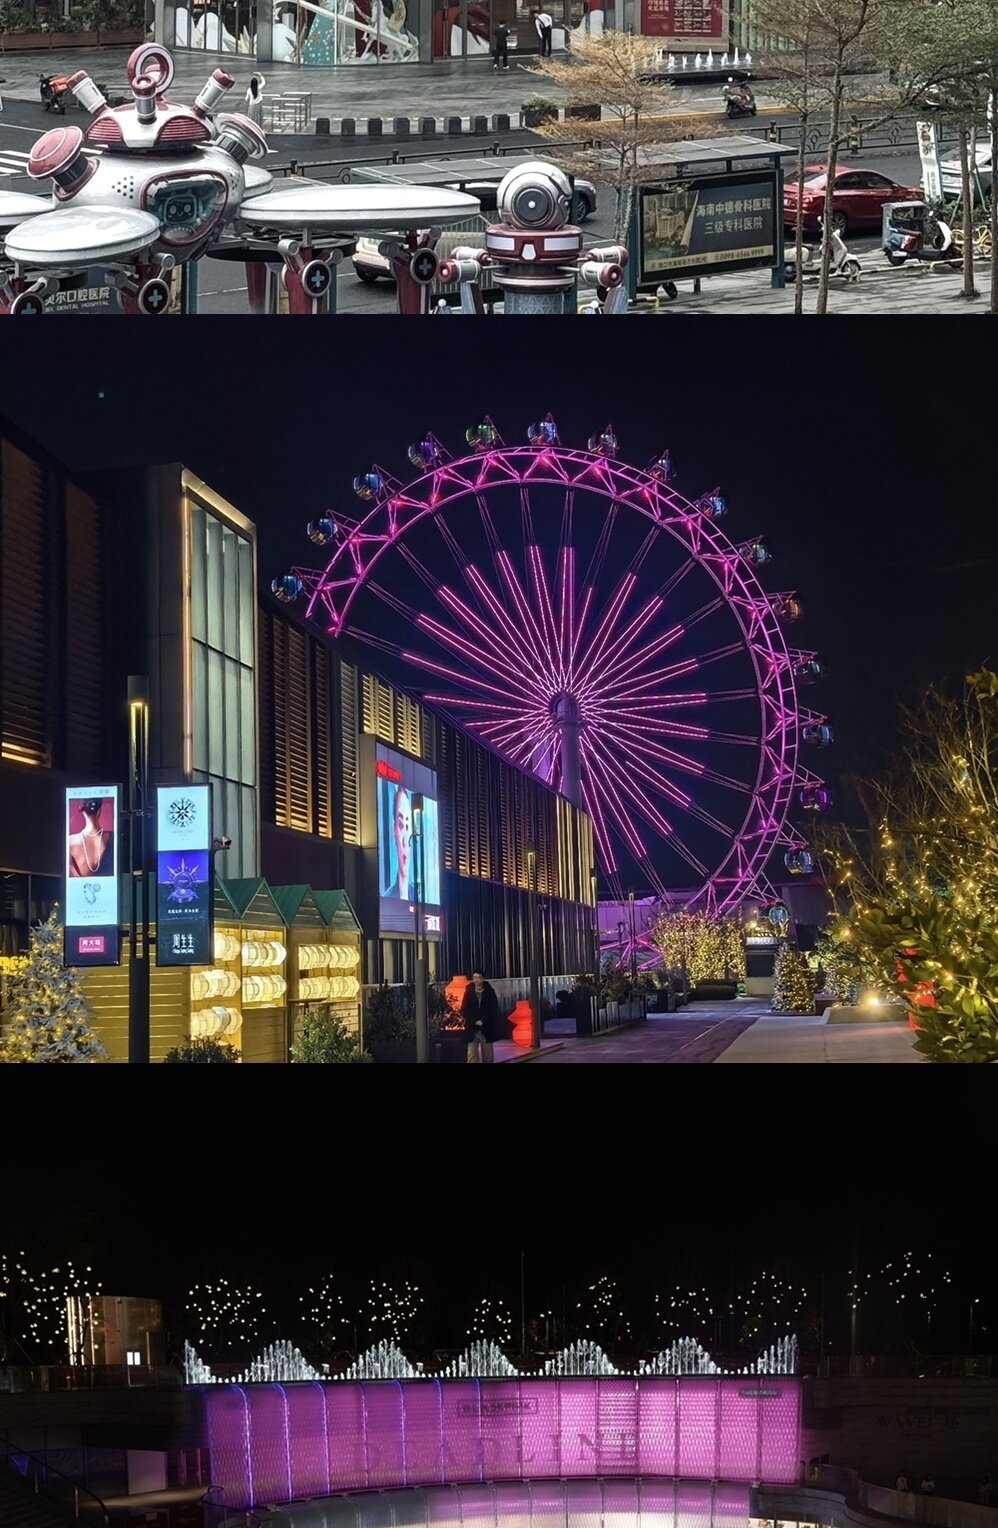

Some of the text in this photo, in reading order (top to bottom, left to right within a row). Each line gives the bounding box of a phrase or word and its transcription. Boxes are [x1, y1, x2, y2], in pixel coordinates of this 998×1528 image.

[696, 197, 772, 217] 海南中德骨科医院
[704, 216, 763, 235] 三级专科医院
[57, 304, 78, 312] DENTAL
[81, 300, 110, 308] HOSPITAL
